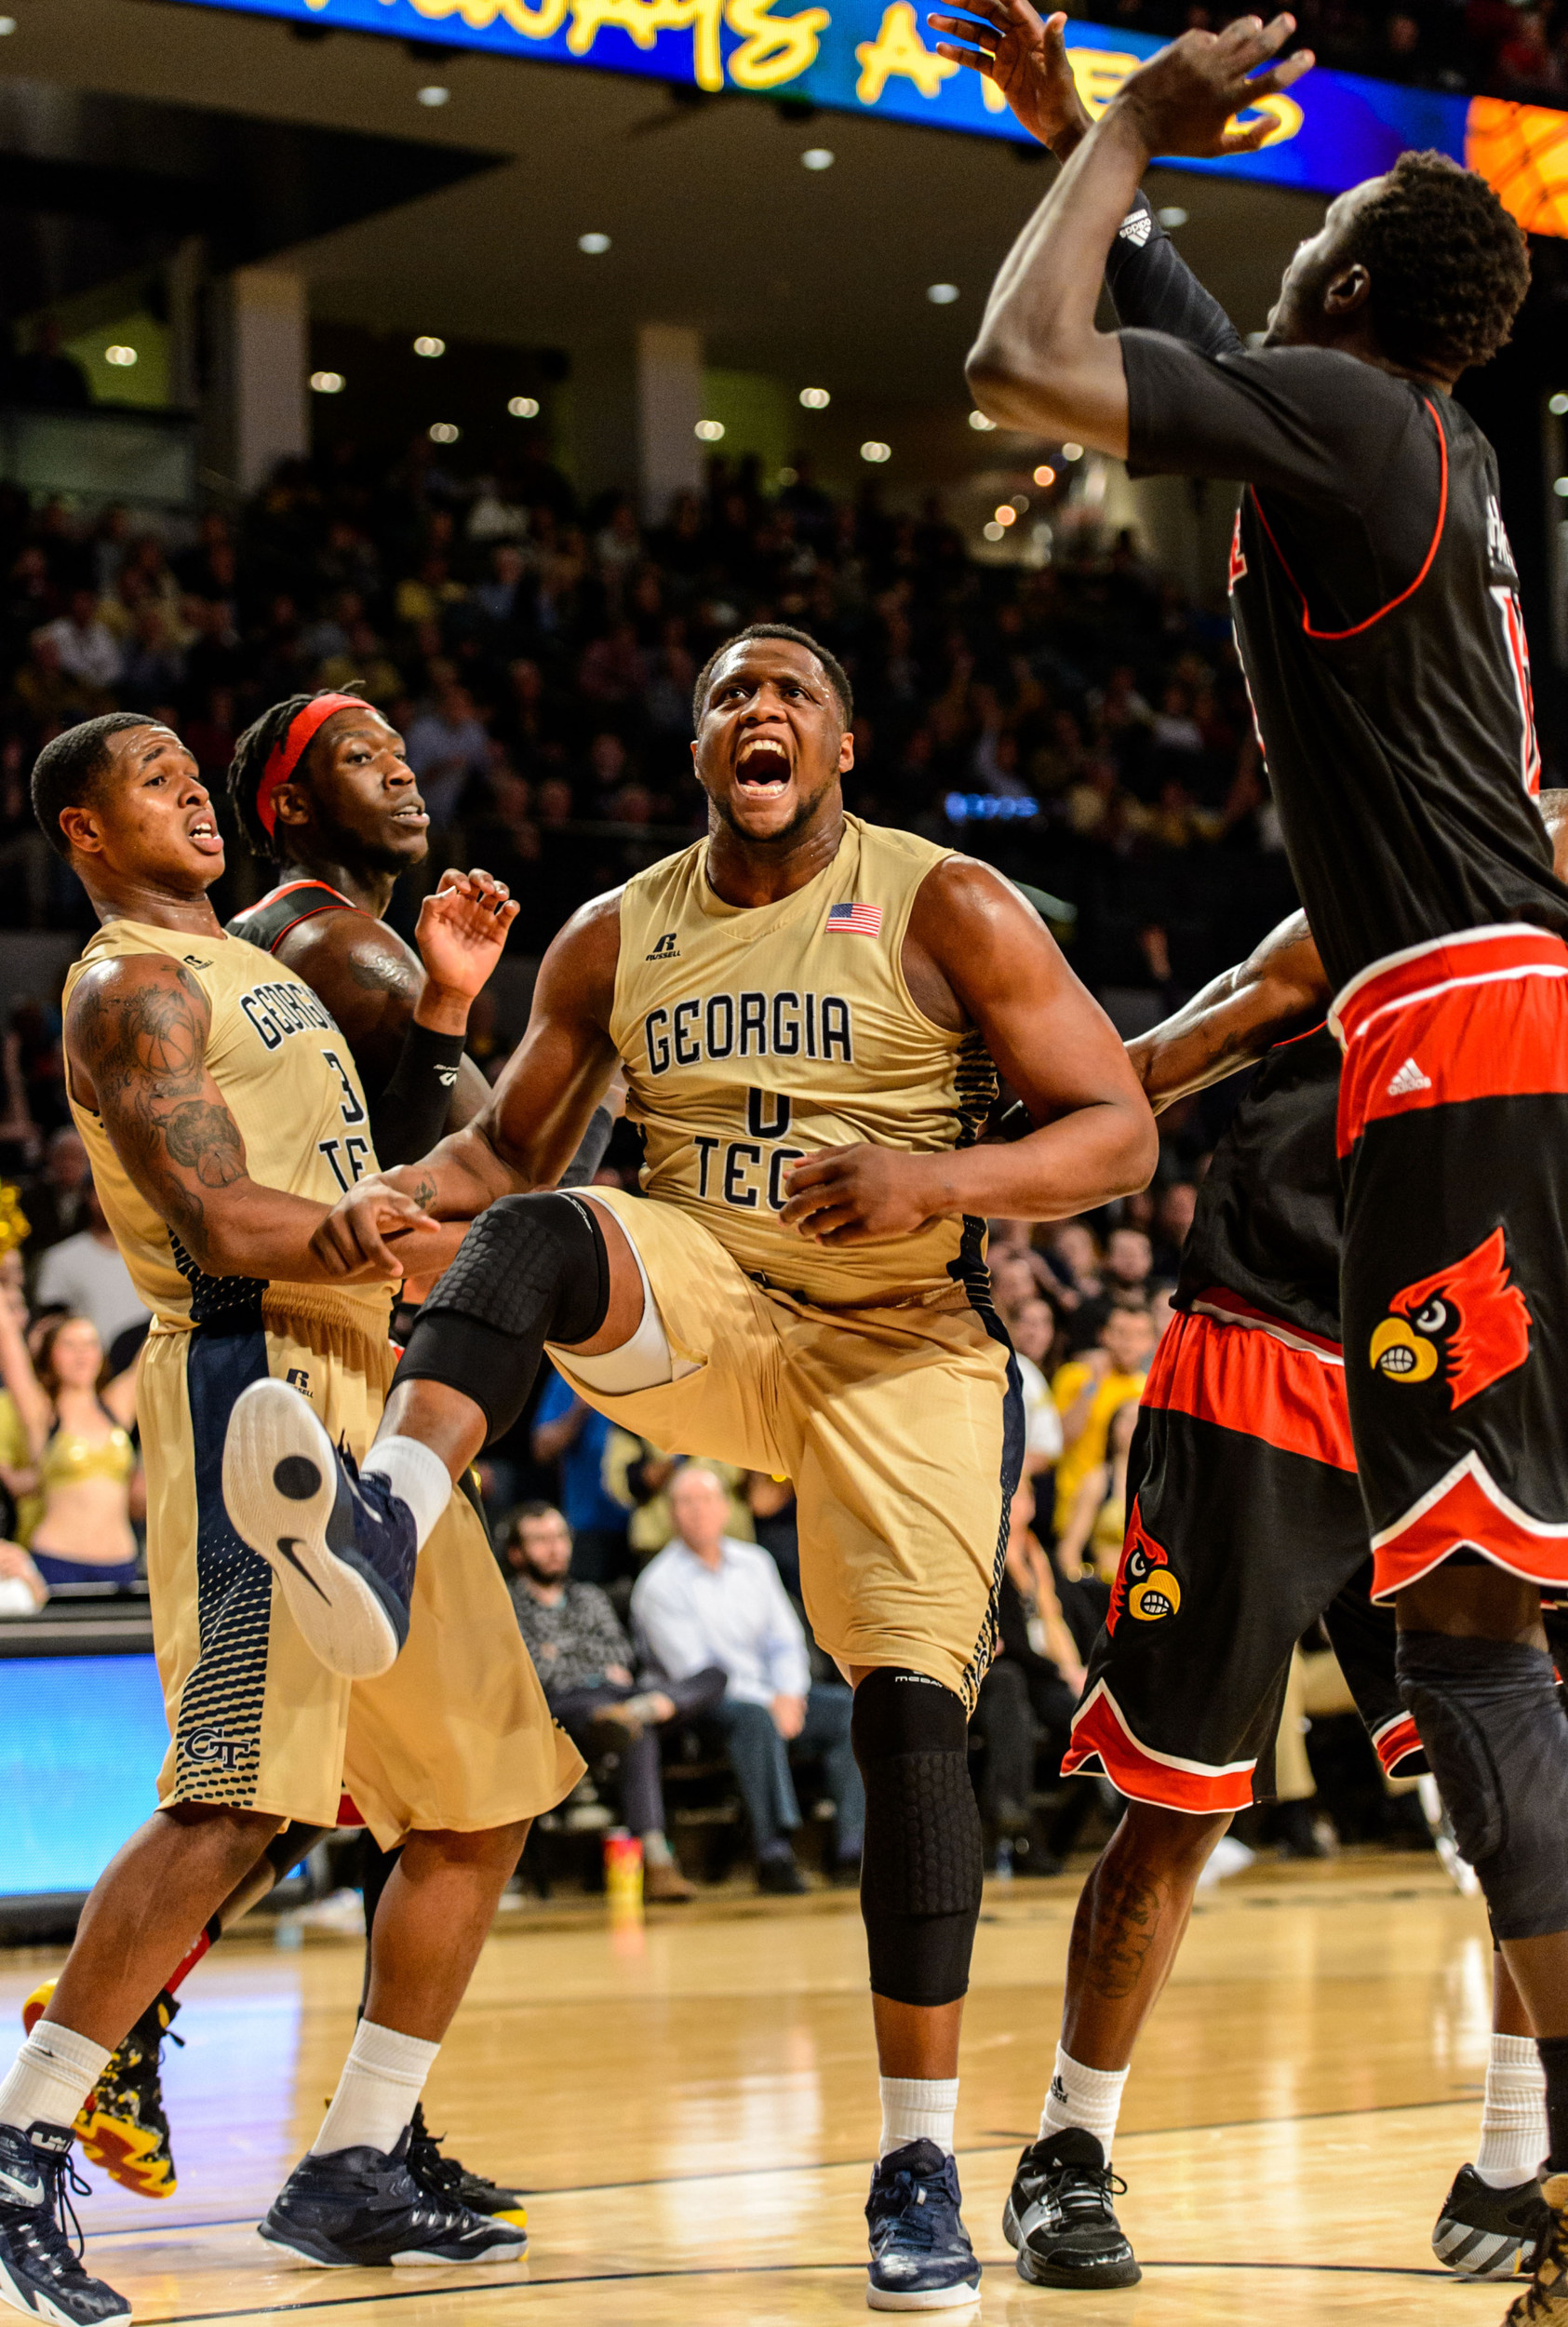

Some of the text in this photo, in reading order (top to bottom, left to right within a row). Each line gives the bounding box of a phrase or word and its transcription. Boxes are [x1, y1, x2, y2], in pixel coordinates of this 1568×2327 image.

[645, 950, 681, 962] RUSSELL
[645, 990, 854, 1077] GEORGIA
[320, 1048, 367, 1126] 3
[1387, 1076, 1432, 1096] adidas
[318, 1137, 373, 1195] TE
[692, 1135, 808, 1212] TEC
